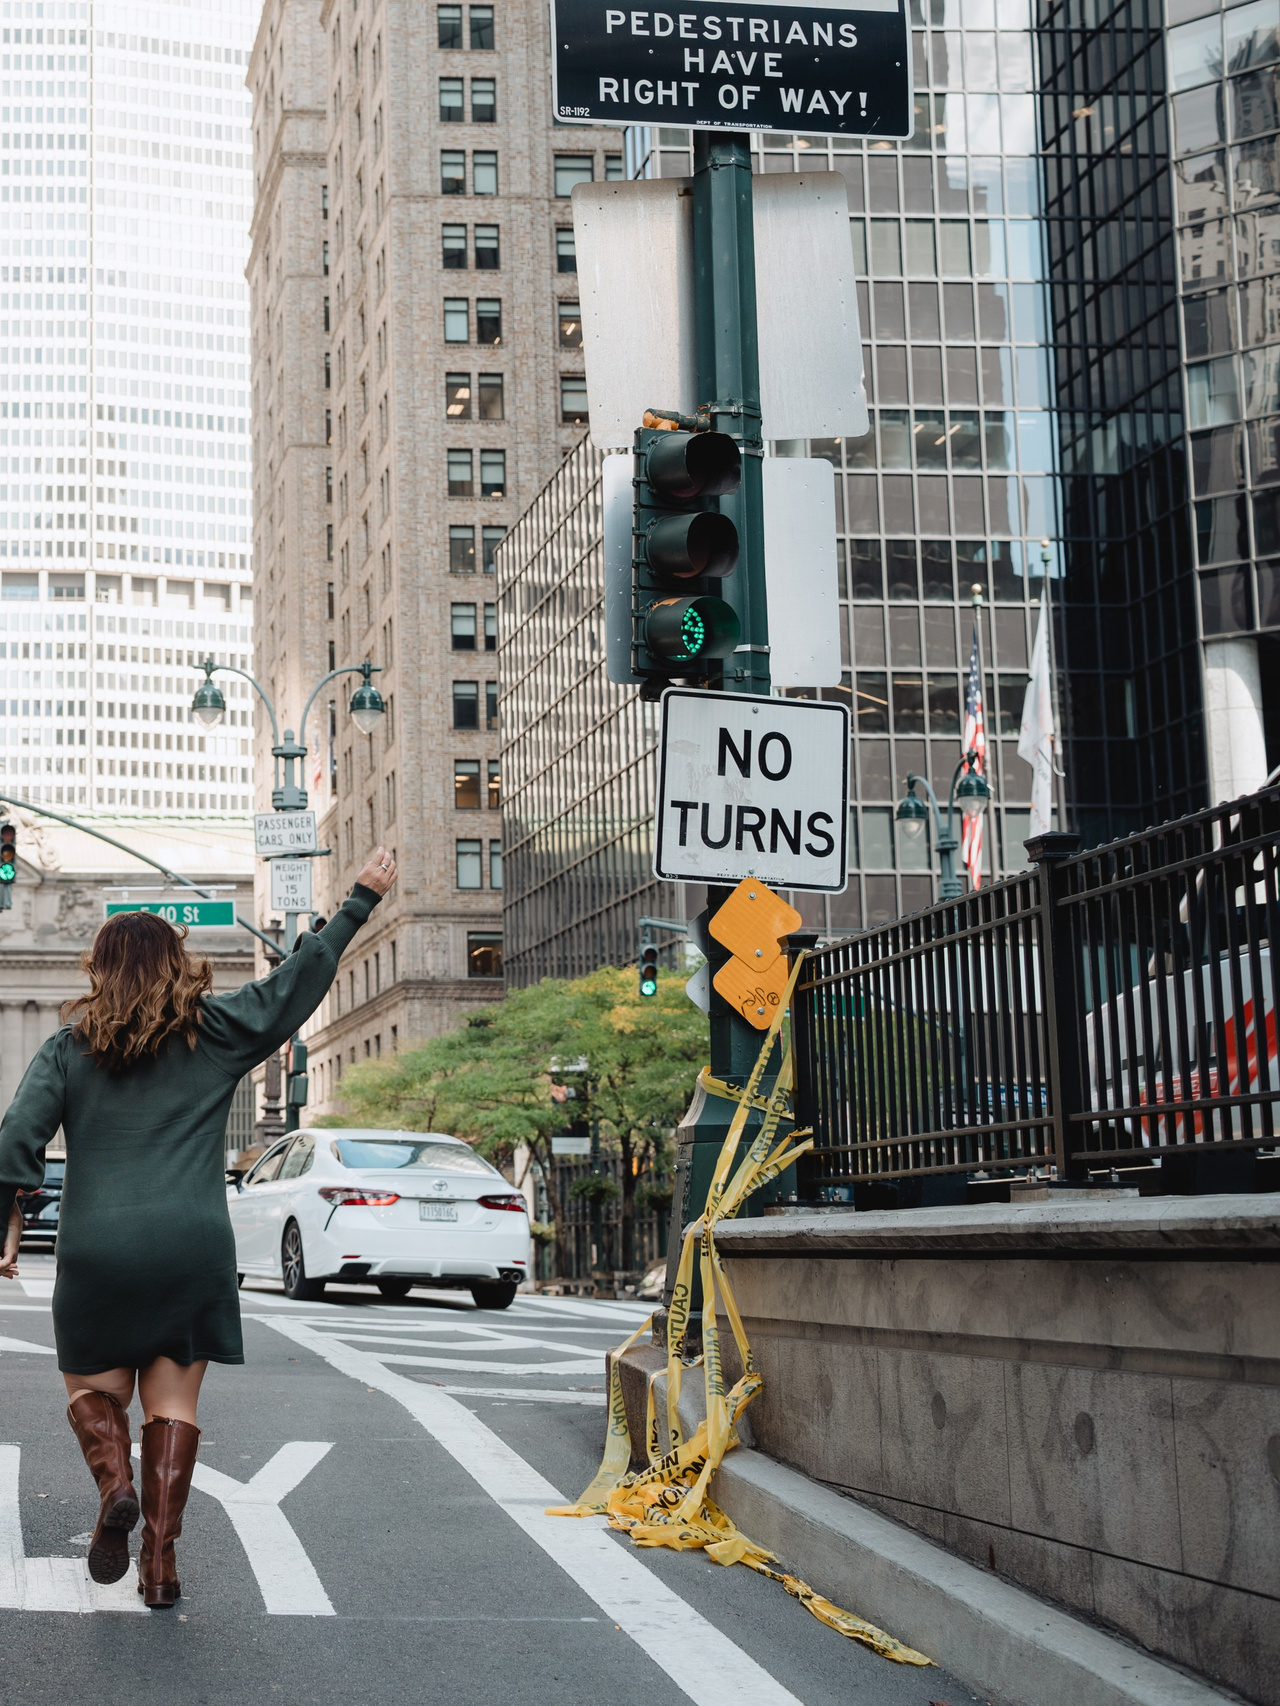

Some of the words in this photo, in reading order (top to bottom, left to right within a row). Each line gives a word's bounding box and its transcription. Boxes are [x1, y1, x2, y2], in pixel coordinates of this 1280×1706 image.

[605, 9, 858, 48] PEDESTRIANS
[684, 47, 783, 78] HAVE
[599, 77, 700, 107] RIGHT
[718, 84, 761, 110] OF
[779, 87, 868, 117] WAY!
[559, 106, 590, 117] SR-1192
[723, 121, 773, 129] TRANSPORTATION
[717, 727, 792, 781] NO
[258, 817, 312, 831] PASSENGER
[671, 800, 835, 858] TURNS
[258, 834, 283, 846] CARS
[289, 832, 312, 844] ONLY
[275, 863, 307, 872] WEIGHT
[280, 874, 302, 882] LIMIT
[285, 884, 297, 894] 15
[277, 897, 306, 907] TONS
[157, 906, 177, 922] 40
[183, 906, 199, 923] St
